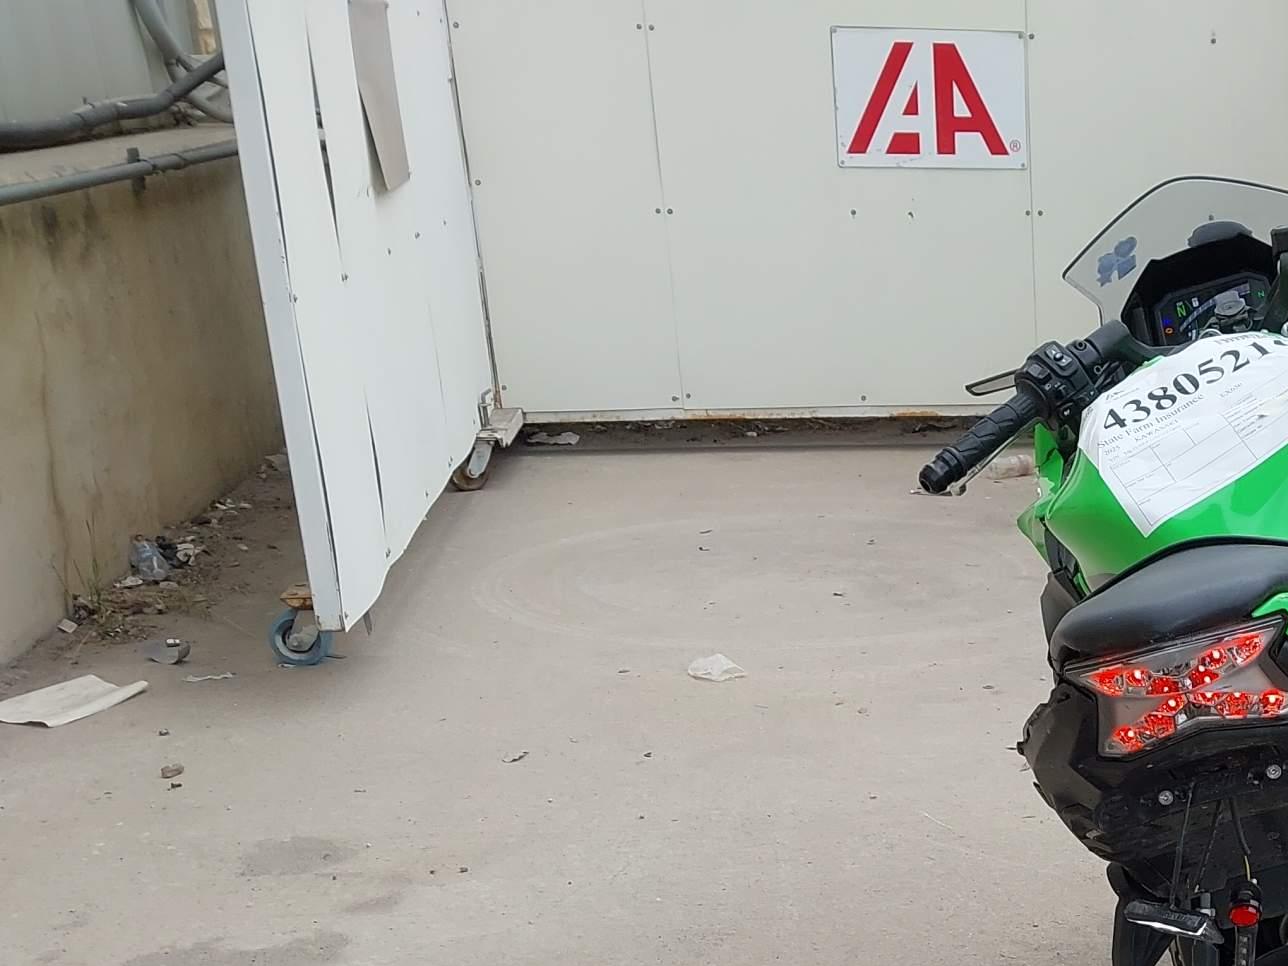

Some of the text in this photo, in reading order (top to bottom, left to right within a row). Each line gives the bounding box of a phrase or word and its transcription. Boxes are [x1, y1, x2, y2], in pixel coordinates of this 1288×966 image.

[1097, 433, 1123, 449] State
[1126, 421, 1154, 437] Farm
[1155, 394, 1204, 425] Insurance
